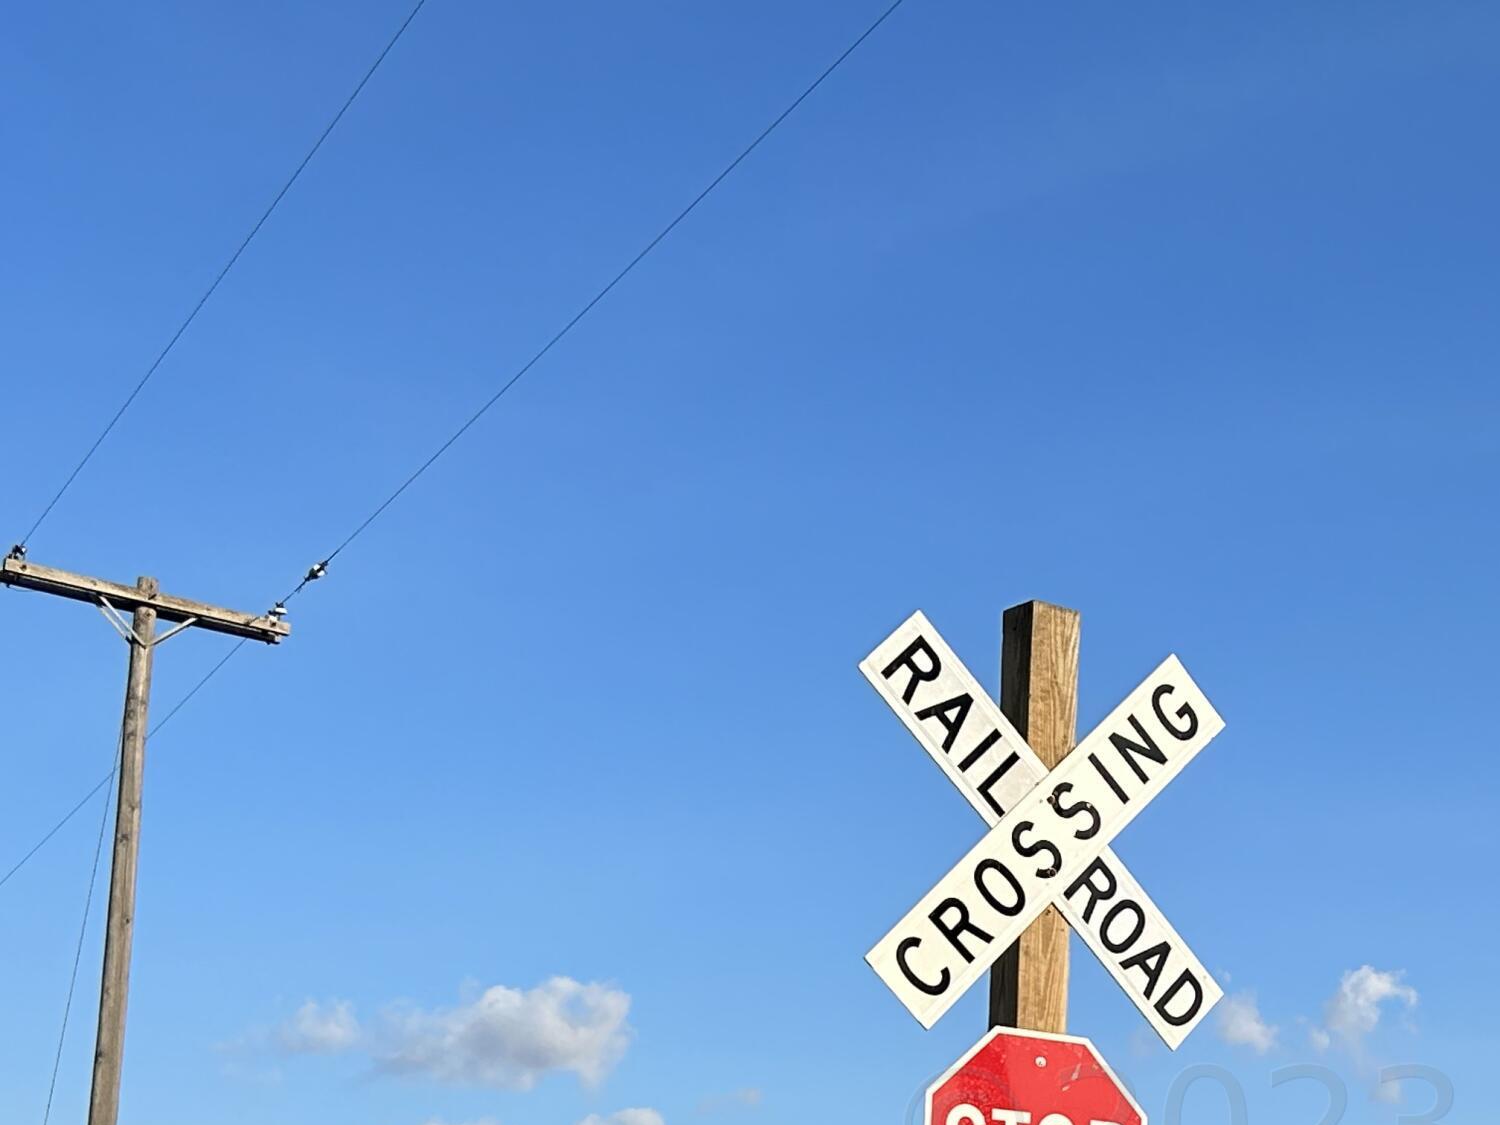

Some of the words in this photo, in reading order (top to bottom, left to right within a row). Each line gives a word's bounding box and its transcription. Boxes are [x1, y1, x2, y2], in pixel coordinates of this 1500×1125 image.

[881, 635, 1021, 816] RAIL
[1063, 855, 1204, 1028] ROAD
[895, 683, 1199, 996] CROSSING
